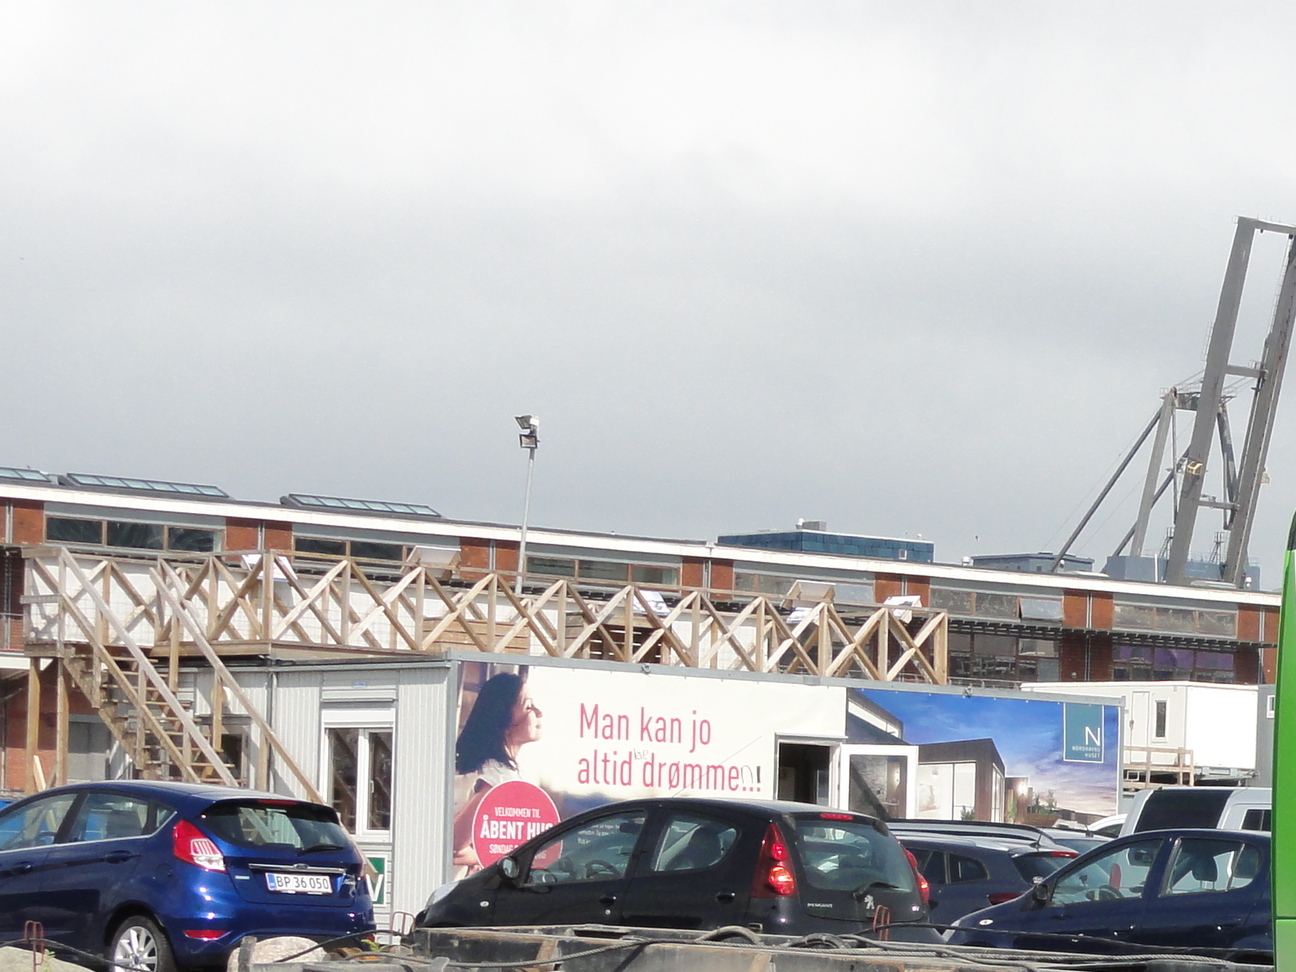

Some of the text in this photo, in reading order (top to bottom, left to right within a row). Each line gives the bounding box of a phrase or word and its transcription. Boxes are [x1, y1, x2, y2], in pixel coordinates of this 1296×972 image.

[579, 702, 711, 754] Man kan jo
[1085, 726, 1101, 746] N
[577, 749, 632, 786] altid
[494, 806, 531, 818] VELKOMMEN
[480, 814, 525, 840] ÅBENT
[276, 876, 329, 890] BP 36 050
